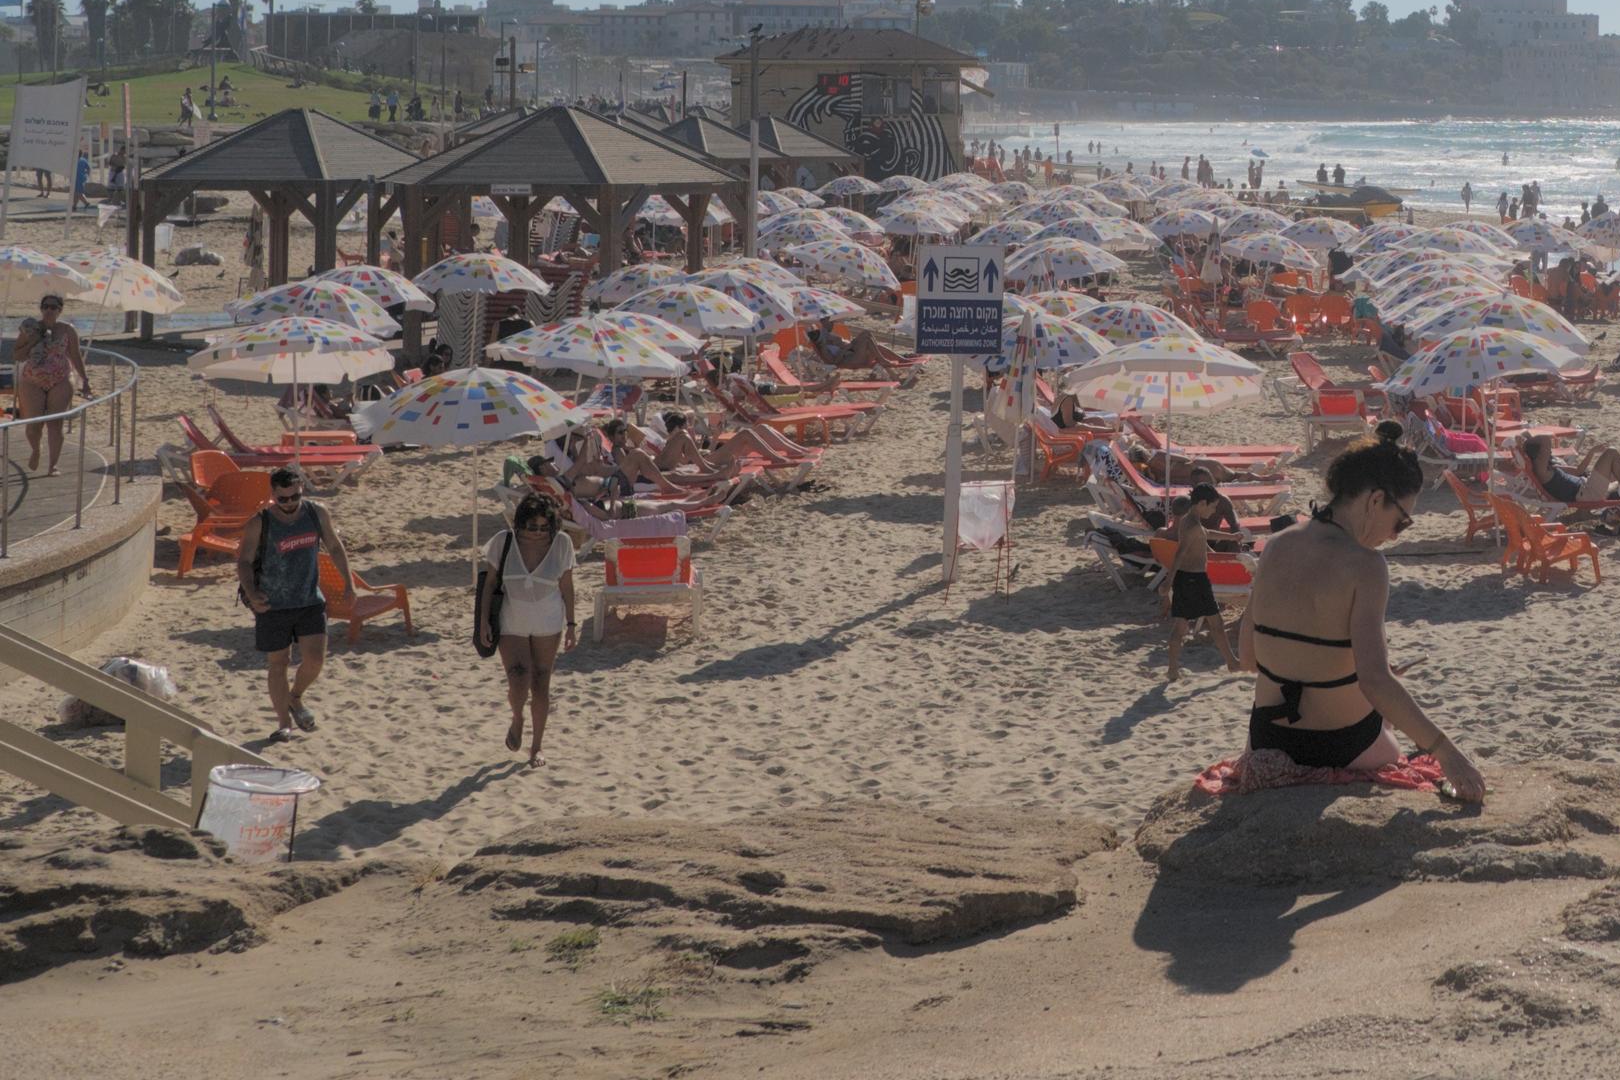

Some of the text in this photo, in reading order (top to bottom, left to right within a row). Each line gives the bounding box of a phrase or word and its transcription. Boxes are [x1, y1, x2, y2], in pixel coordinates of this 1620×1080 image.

[923, 306, 998, 323] מקום רחצה מוכרז
[980, 324, 998, 336] مكان
[921, 338, 998, 347] AUTHORIZED SWIMMING ZONE
